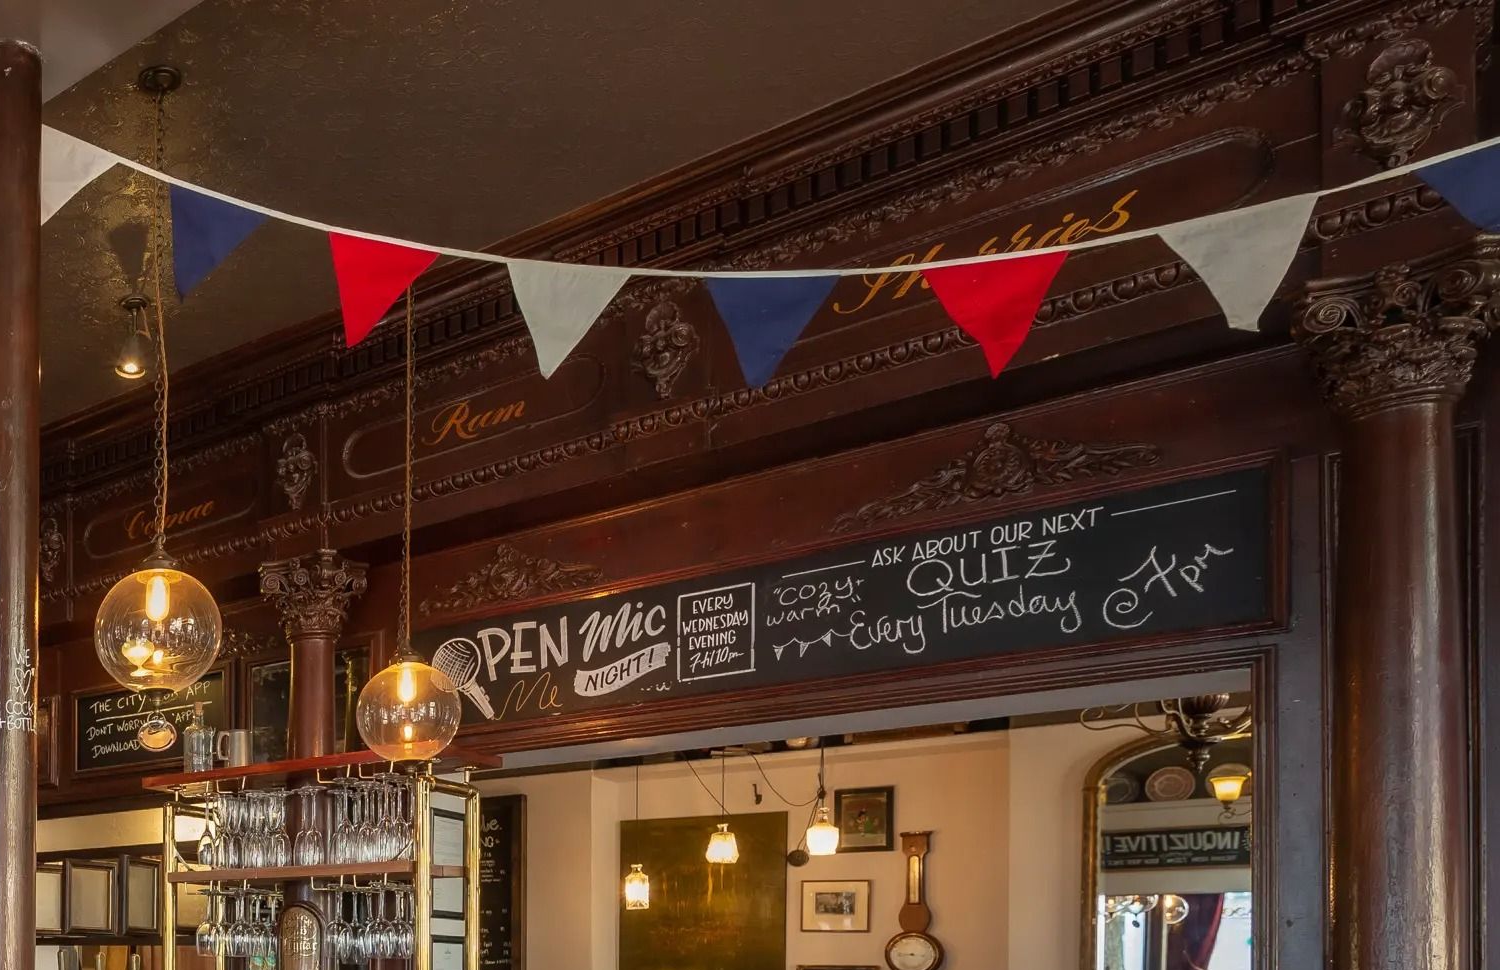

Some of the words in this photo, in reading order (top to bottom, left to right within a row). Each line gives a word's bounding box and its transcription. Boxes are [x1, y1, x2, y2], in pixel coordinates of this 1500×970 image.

[833, 188, 1140, 314] Shrries
[421, 398, 526, 447] Rum
[870, 545, 904, 569] ASK
[911, 530, 983, 562] ABOUT
[990, 521, 1033, 546] OUR
[1041, 505, 1104, 536] NEXT
[906, 539, 1072, 600] QUIZ
[682, 608, 749, 636] WEDNESDAY
[692, 592, 734, 615] EVERY
[848, 609, 926, 655] Every
[917, 584, 1083, 635] Tuesday
[1101, 586, 1154, 630] @
[578, 600, 667, 662] Mic
[688, 629, 737, 651] EVENING
[185, 680, 211, 700] APP
[584, 645, 656, 693] NIGHT!
[89, 698, 112, 715] THE
[116, 691, 147, 713] CITY
